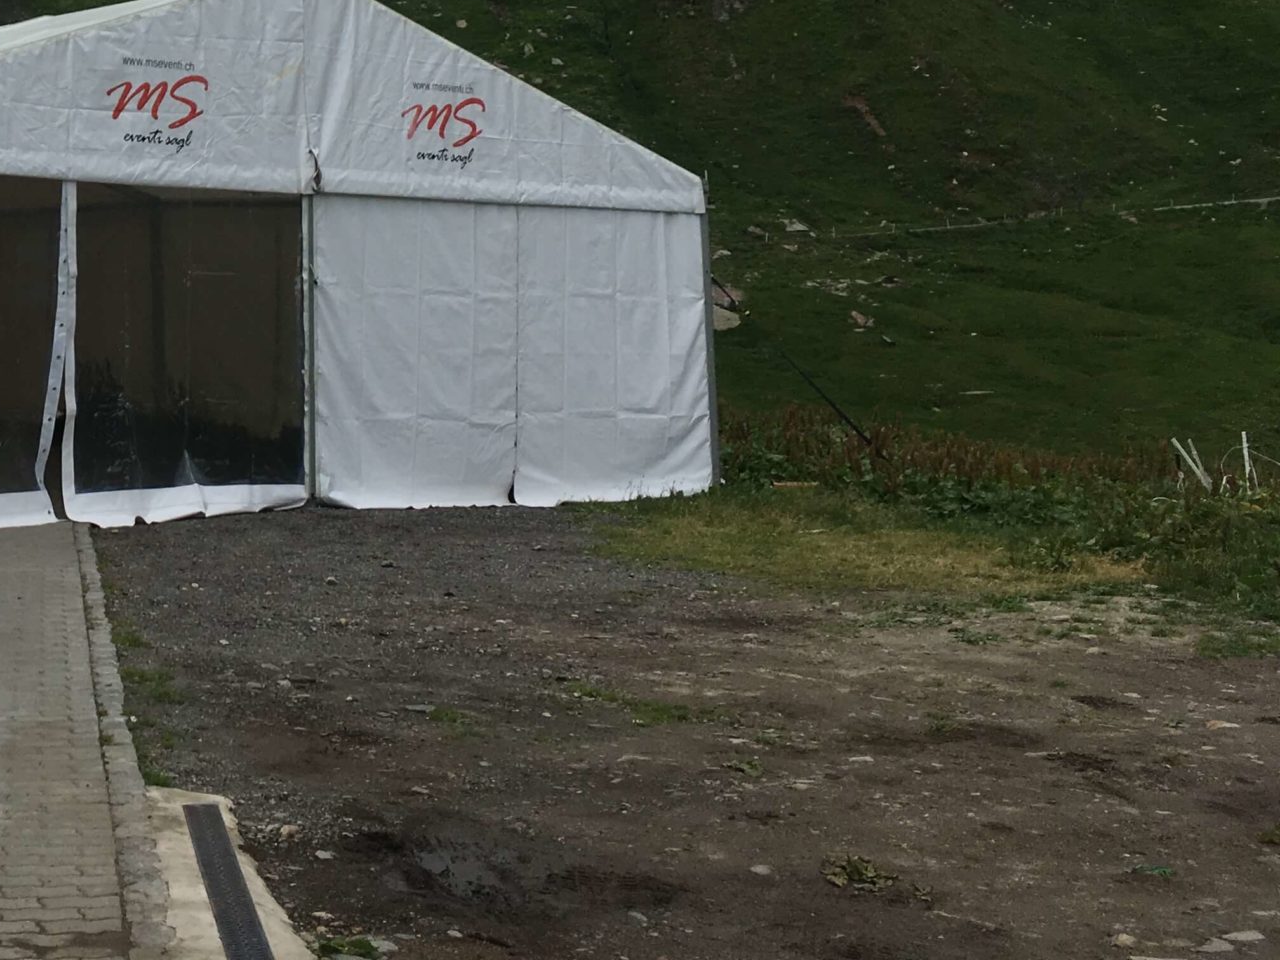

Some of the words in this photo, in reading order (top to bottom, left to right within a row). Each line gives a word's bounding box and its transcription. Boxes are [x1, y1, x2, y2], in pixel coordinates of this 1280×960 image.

[123, 129, 162, 144] eventi
[165, 130, 193, 154] sagl
[416, 148, 449, 162] eventi
